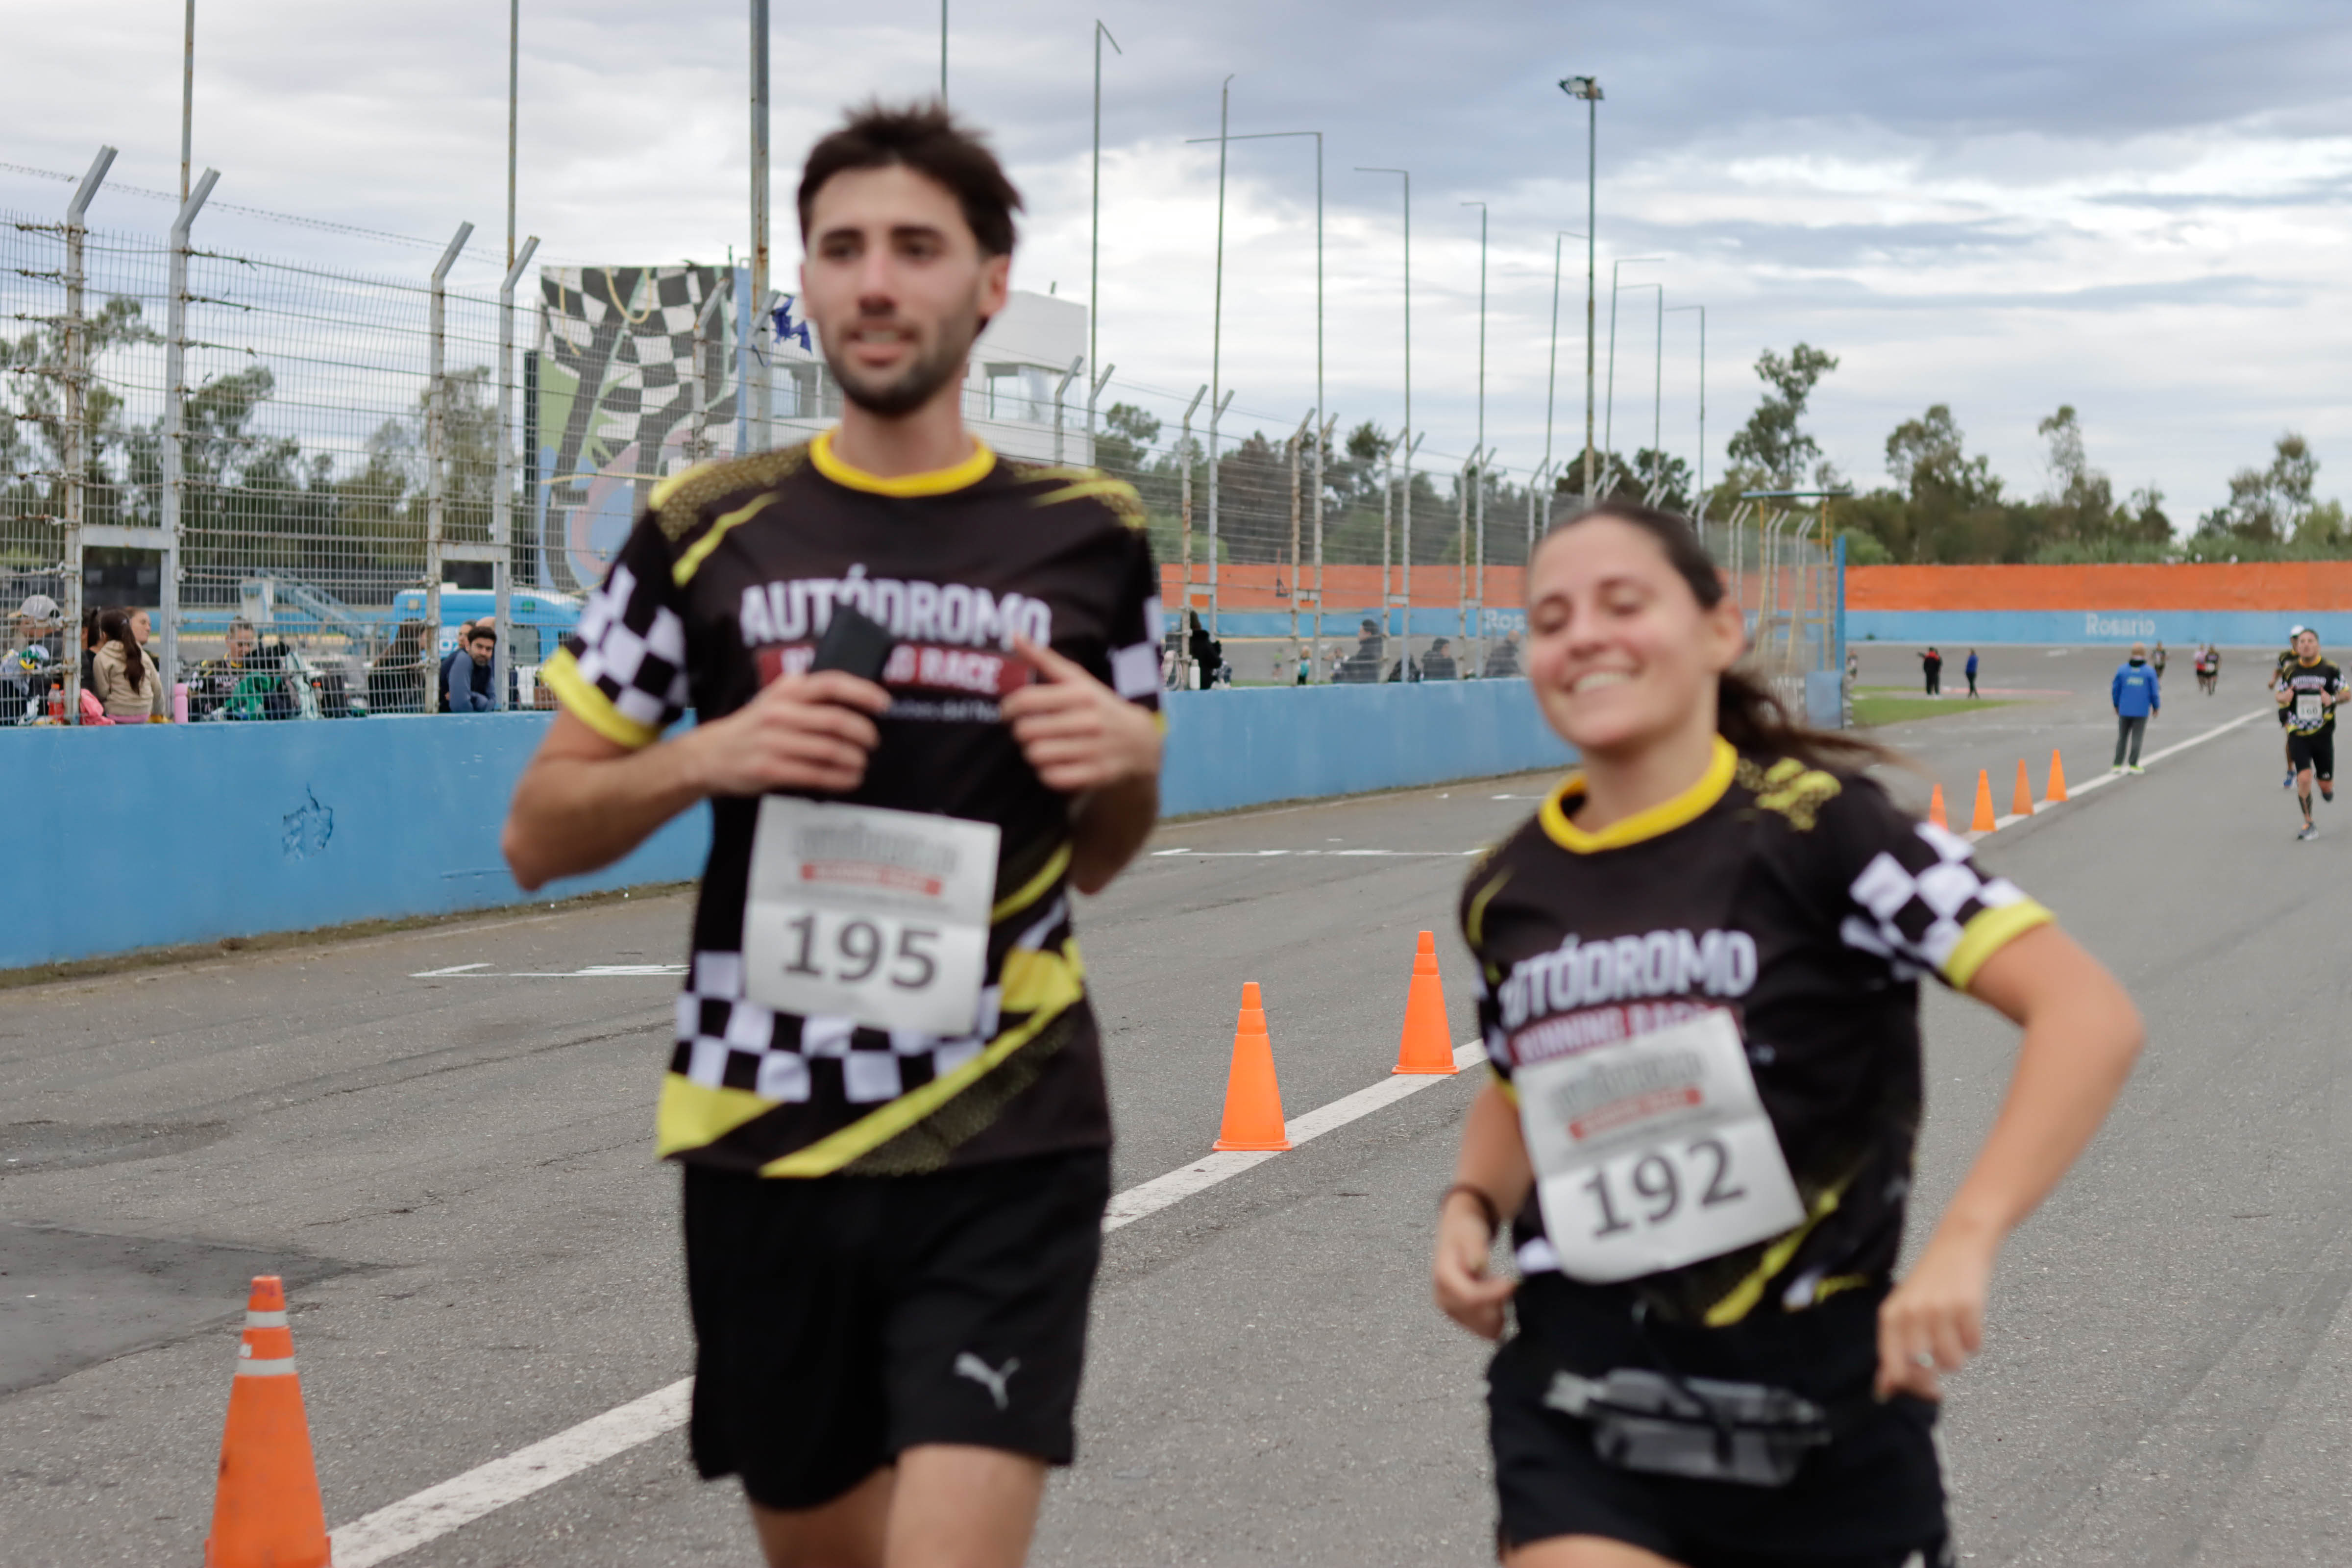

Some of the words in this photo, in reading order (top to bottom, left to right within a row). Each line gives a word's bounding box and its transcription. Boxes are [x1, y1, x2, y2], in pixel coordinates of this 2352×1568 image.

[2086, 612, 2156, 636] Rosario
[919, 648, 1003, 694] RACE
[784, 914, 938, 989] 195
[1498, 929, 1758, 1029] UTÓDROMO
[1582, 1139, 1747, 1238] 192
